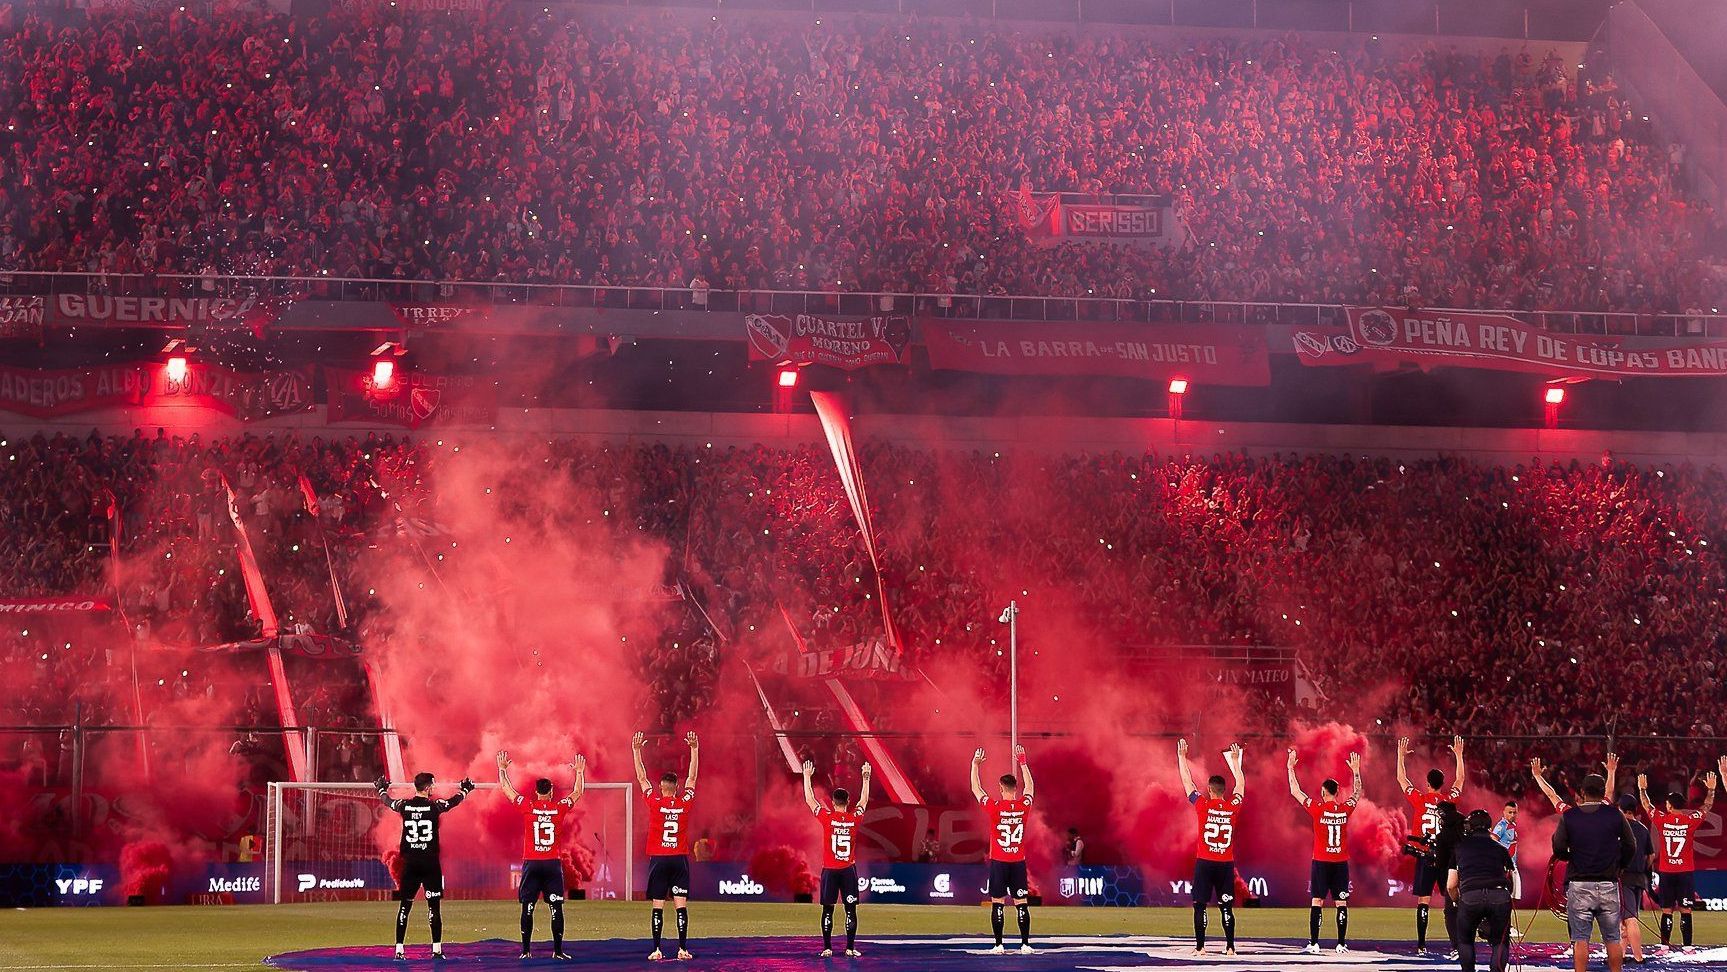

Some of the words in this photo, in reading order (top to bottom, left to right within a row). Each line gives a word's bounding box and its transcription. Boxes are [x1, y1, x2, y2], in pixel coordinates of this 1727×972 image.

[1072, 211, 1158, 233] BERISSO
[796, 314, 866, 339] CUARTEL
[812, 336, 871, 355] MORENO
[981, 340, 1011, 357] LA
[1020, 341, 1100, 357] BARRA
[1116, 342, 1149, 361] SAN
[1152, 343, 1217, 365] JUSTO
[1404, 317, 1472, 348] PEÑA
[1479, 324, 1528, 354] REY
[1537, 335, 1568, 361] DE
[1577, 344, 1660, 369] COPAS
[1245, 669, 1290, 684] MATEO
[411, 812, 423, 820] REY
[404, 819, 433, 843] 33
[532, 821, 555, 846] 13
[663, 820, 679, 842] 2
[996, 823, 1024, 847] 34
[1204, 823, 1233, 849] 23
[1327, 825, 1341, 847] 11
[831, 834, 851, 857] 15
[1664, 836, 1686, 858] 17
[55, 879, 103, 895] YPF
[208, 876, 261, 892] Medifé
[319, 878, 365, 888] PedidosYa
[719, 875, 764, 895] Naldo
[870, 877, 896, 886] Correo
[1078, 877, 1103, 896] PLAY
